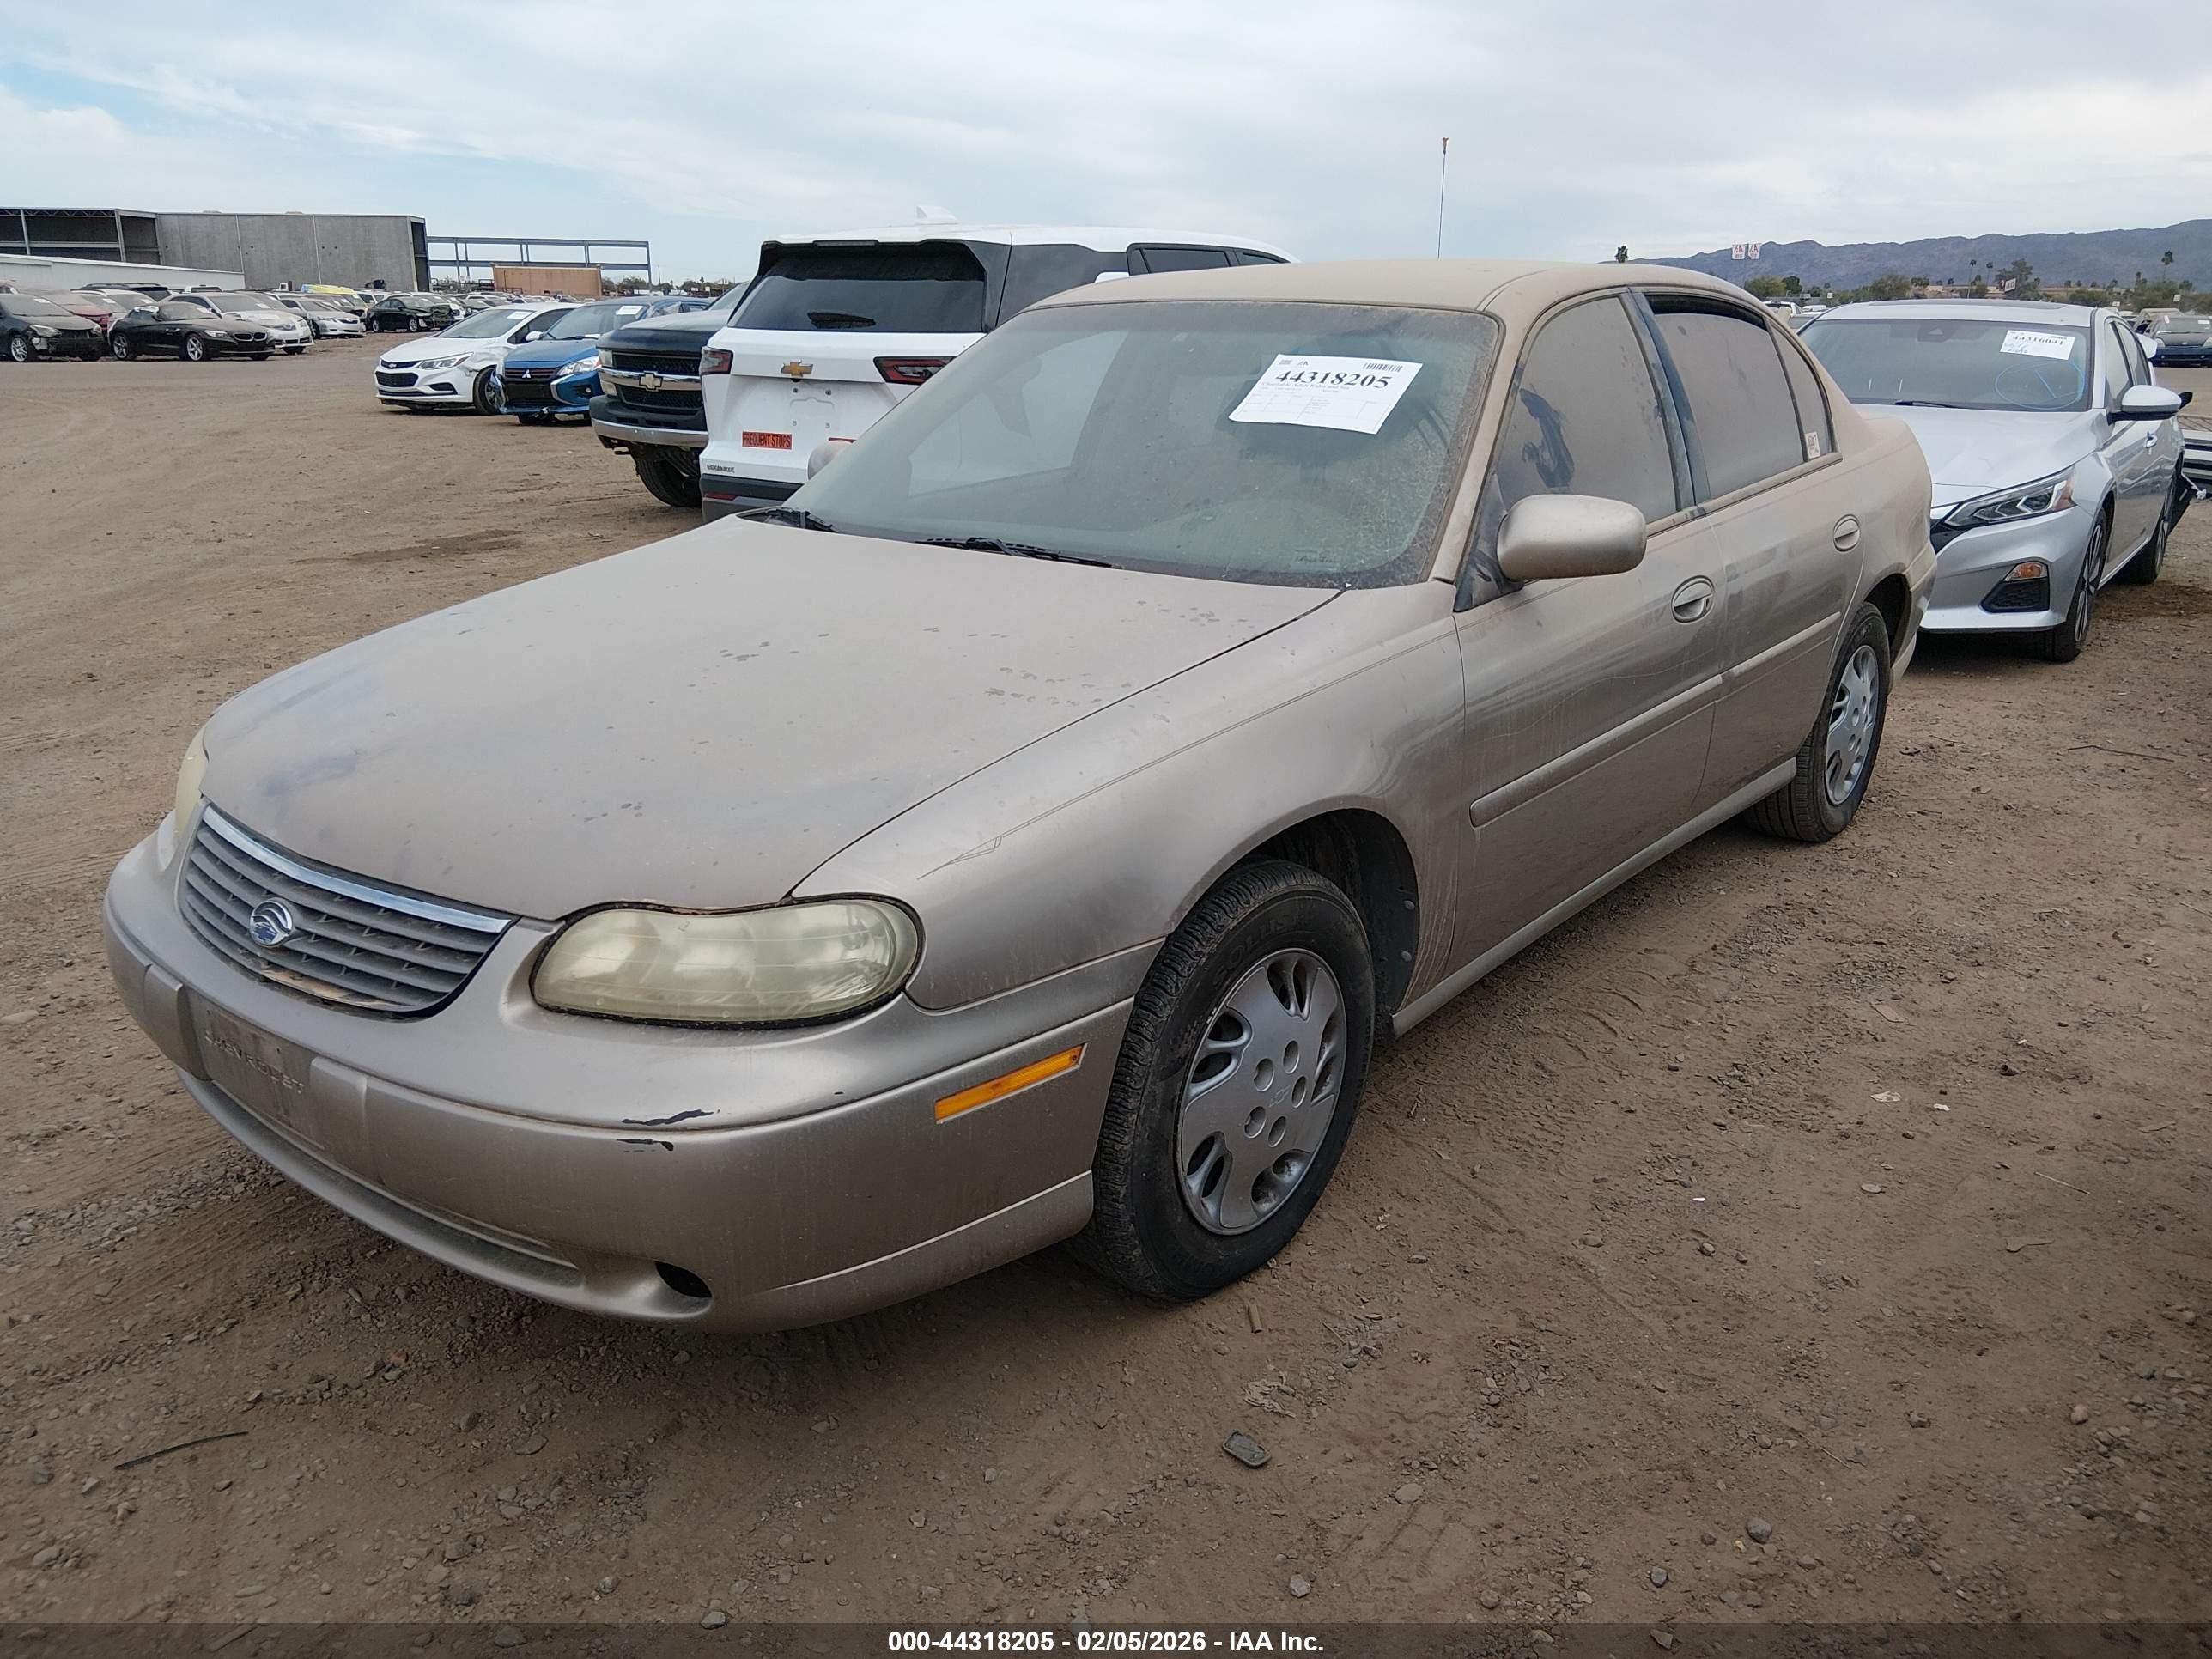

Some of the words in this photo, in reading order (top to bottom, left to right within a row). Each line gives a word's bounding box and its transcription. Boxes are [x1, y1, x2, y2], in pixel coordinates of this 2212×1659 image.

[1276, 371, 1393, 388] 44318205
[743, 432, 770, 447] FREQUENT
[771, 434, 792, 448] STOPS
